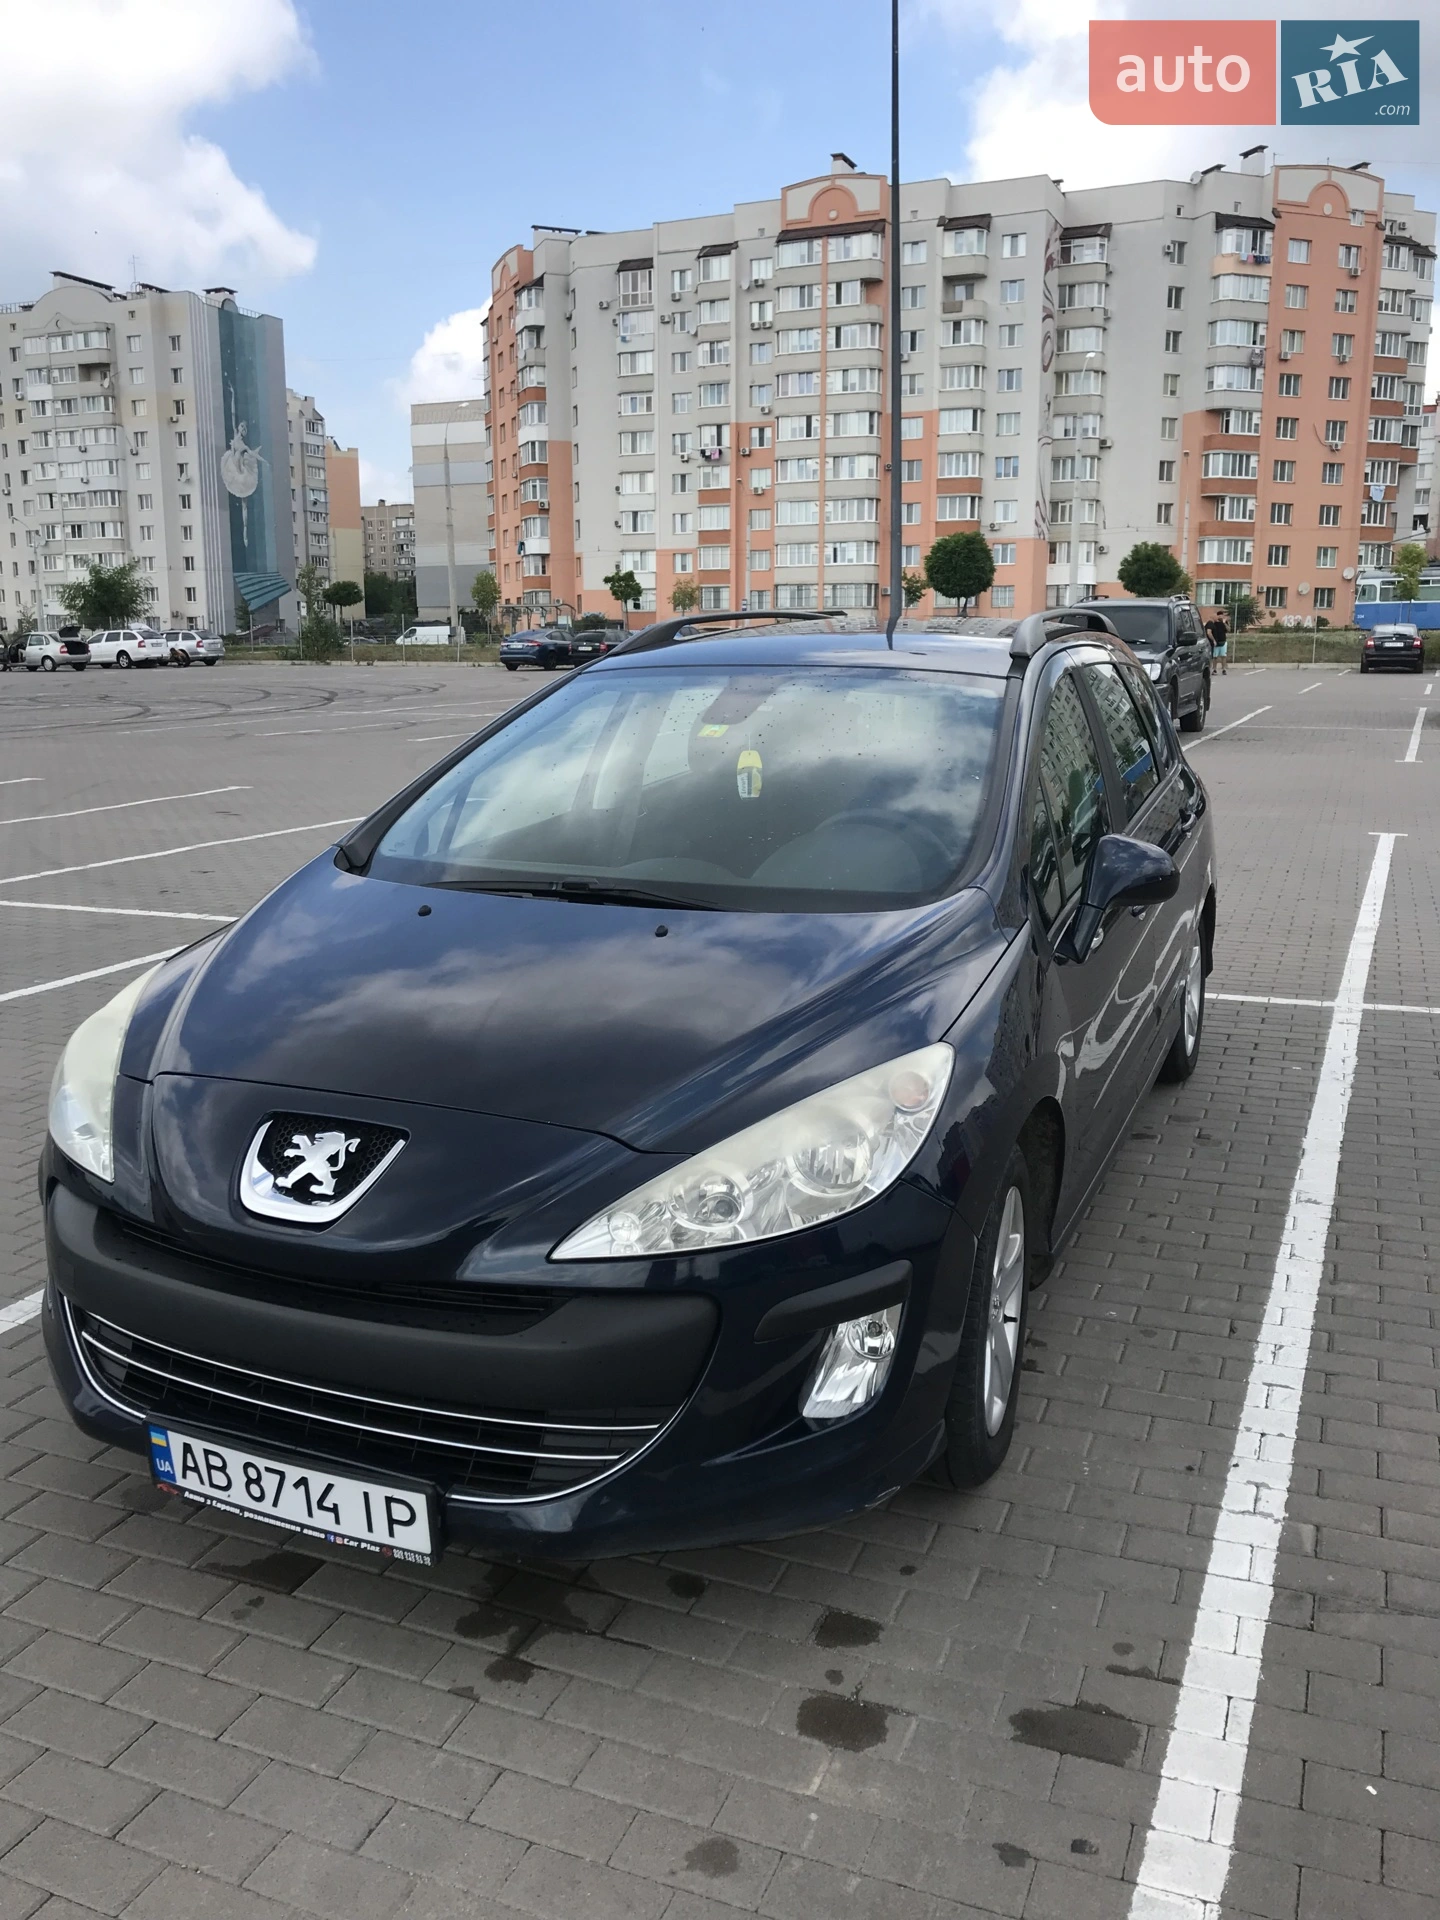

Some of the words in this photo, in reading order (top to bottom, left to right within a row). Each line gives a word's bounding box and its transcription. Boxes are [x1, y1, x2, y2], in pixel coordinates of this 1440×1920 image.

[156, 1458, 174, 1475] UA
[182, 1442, 232, 1492] AB
[242, 1461, 341, 1526] 8714
[362, 1491, 417, 1539] IP
